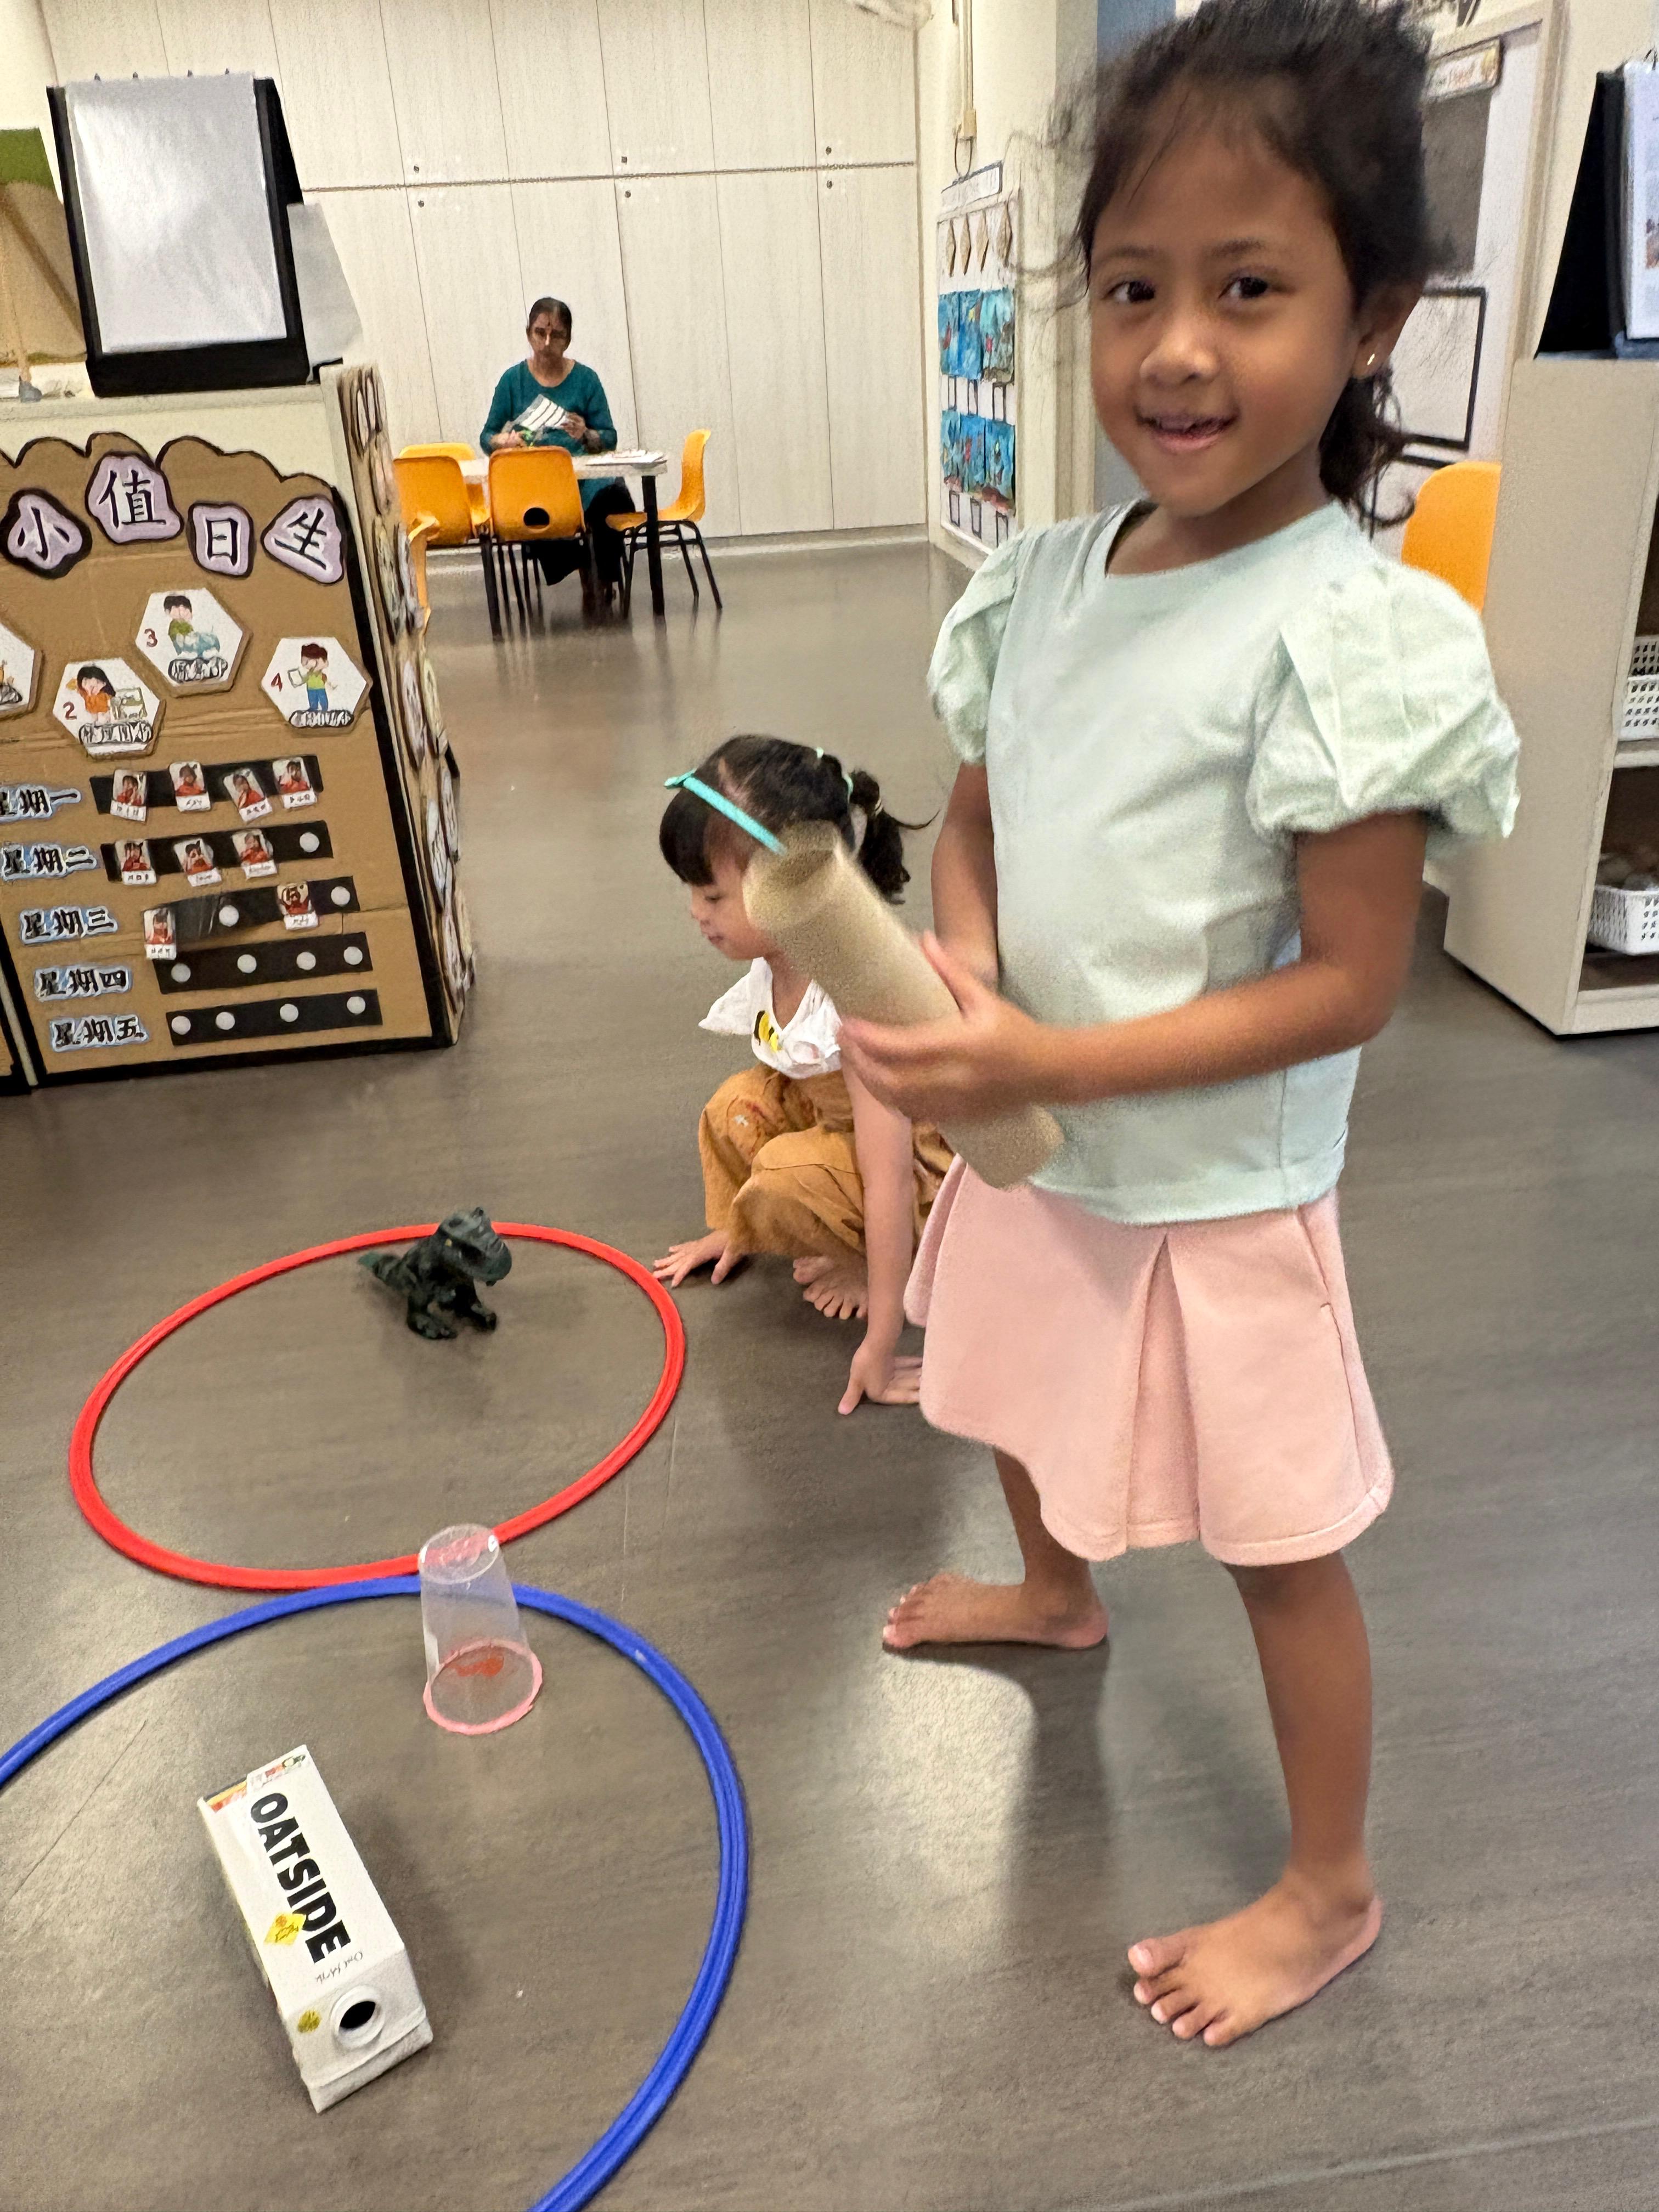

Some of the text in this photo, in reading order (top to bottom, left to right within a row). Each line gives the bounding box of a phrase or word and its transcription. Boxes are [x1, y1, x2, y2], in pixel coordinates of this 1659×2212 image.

[144, 629, 158, 647] 3
[270, 673, 283, 692] 4
[63, 702, 77, 720] 2
[250, 1793, 351, 1963] OATSIDE
